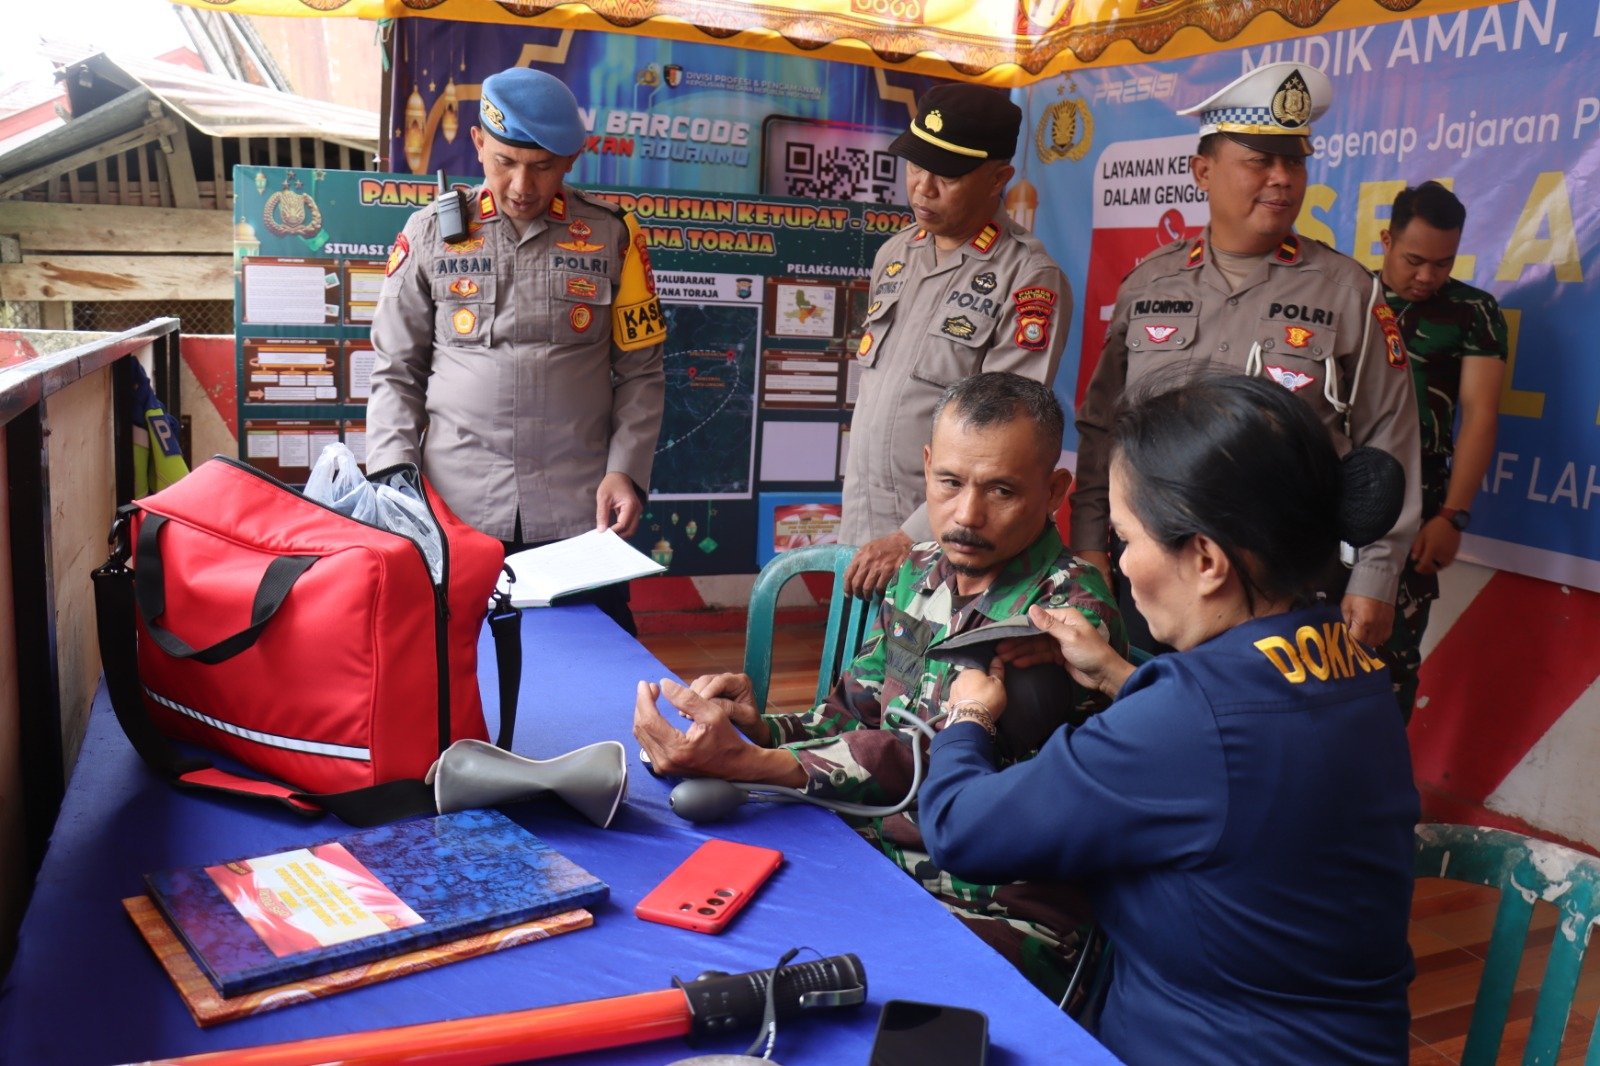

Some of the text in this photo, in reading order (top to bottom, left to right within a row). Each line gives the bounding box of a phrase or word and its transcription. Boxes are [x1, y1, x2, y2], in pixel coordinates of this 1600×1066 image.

[1386, 0, 1568, 68] AMAN,
[686, 71, 714, 82] DIVISI
[714, 75, 752, 86] PROFESI
[1092, 73, 1179, 106] PRESISI
[605, 109, 750, 147] BARCODE
[1312, 126, 1418, 168] egenap
[1426, 110, 1560, 158] Jajaran
[639, 141, 750, 167] ADUANMU
[1102, 158, 1166, 179] LAYANAN
[1103, 184, 1209, 206] DALAM GENGG
[595, 192, 735, 222] POLISIAN
[738, 202, 848, 229] KETUPAT
[325, 242, 385, 256] SITUASI
[688, 229, 775, 255] TORAJA
[438, 258, 492, 273] AKSAN
[554, 256, 609, 274] POLRI
[787, 263, 872, 277] PELAKSANAAN
[656, 274, 716, 286] SALUBARANI
[656, 287, 719, 298] TANA TORAJA
[945, 290, 1002, 319] POLRI
[1268, 302, 1334, 326] POLRI
